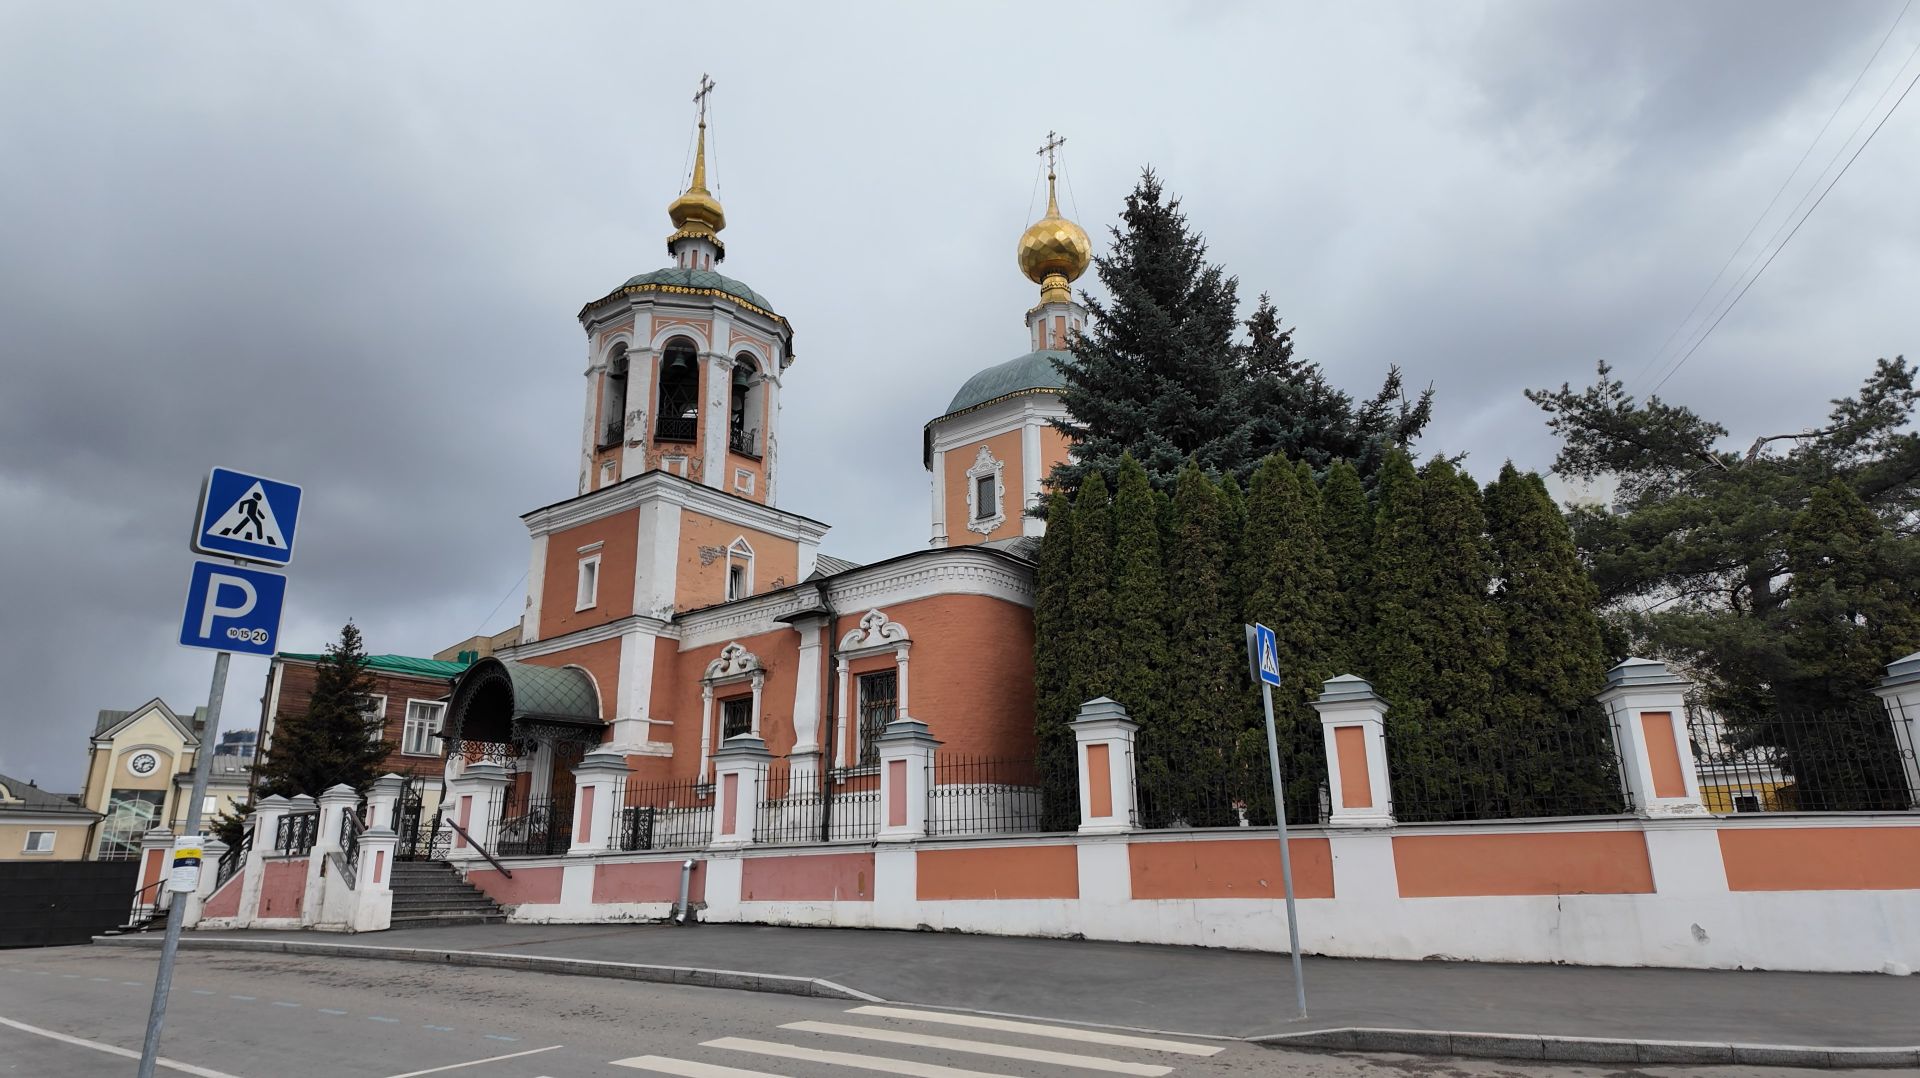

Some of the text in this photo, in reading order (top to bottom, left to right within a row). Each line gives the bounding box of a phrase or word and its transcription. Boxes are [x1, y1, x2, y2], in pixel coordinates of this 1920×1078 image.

[199, 572, 258, 639] P
[229, 629, 268, 642] 10 15 20
